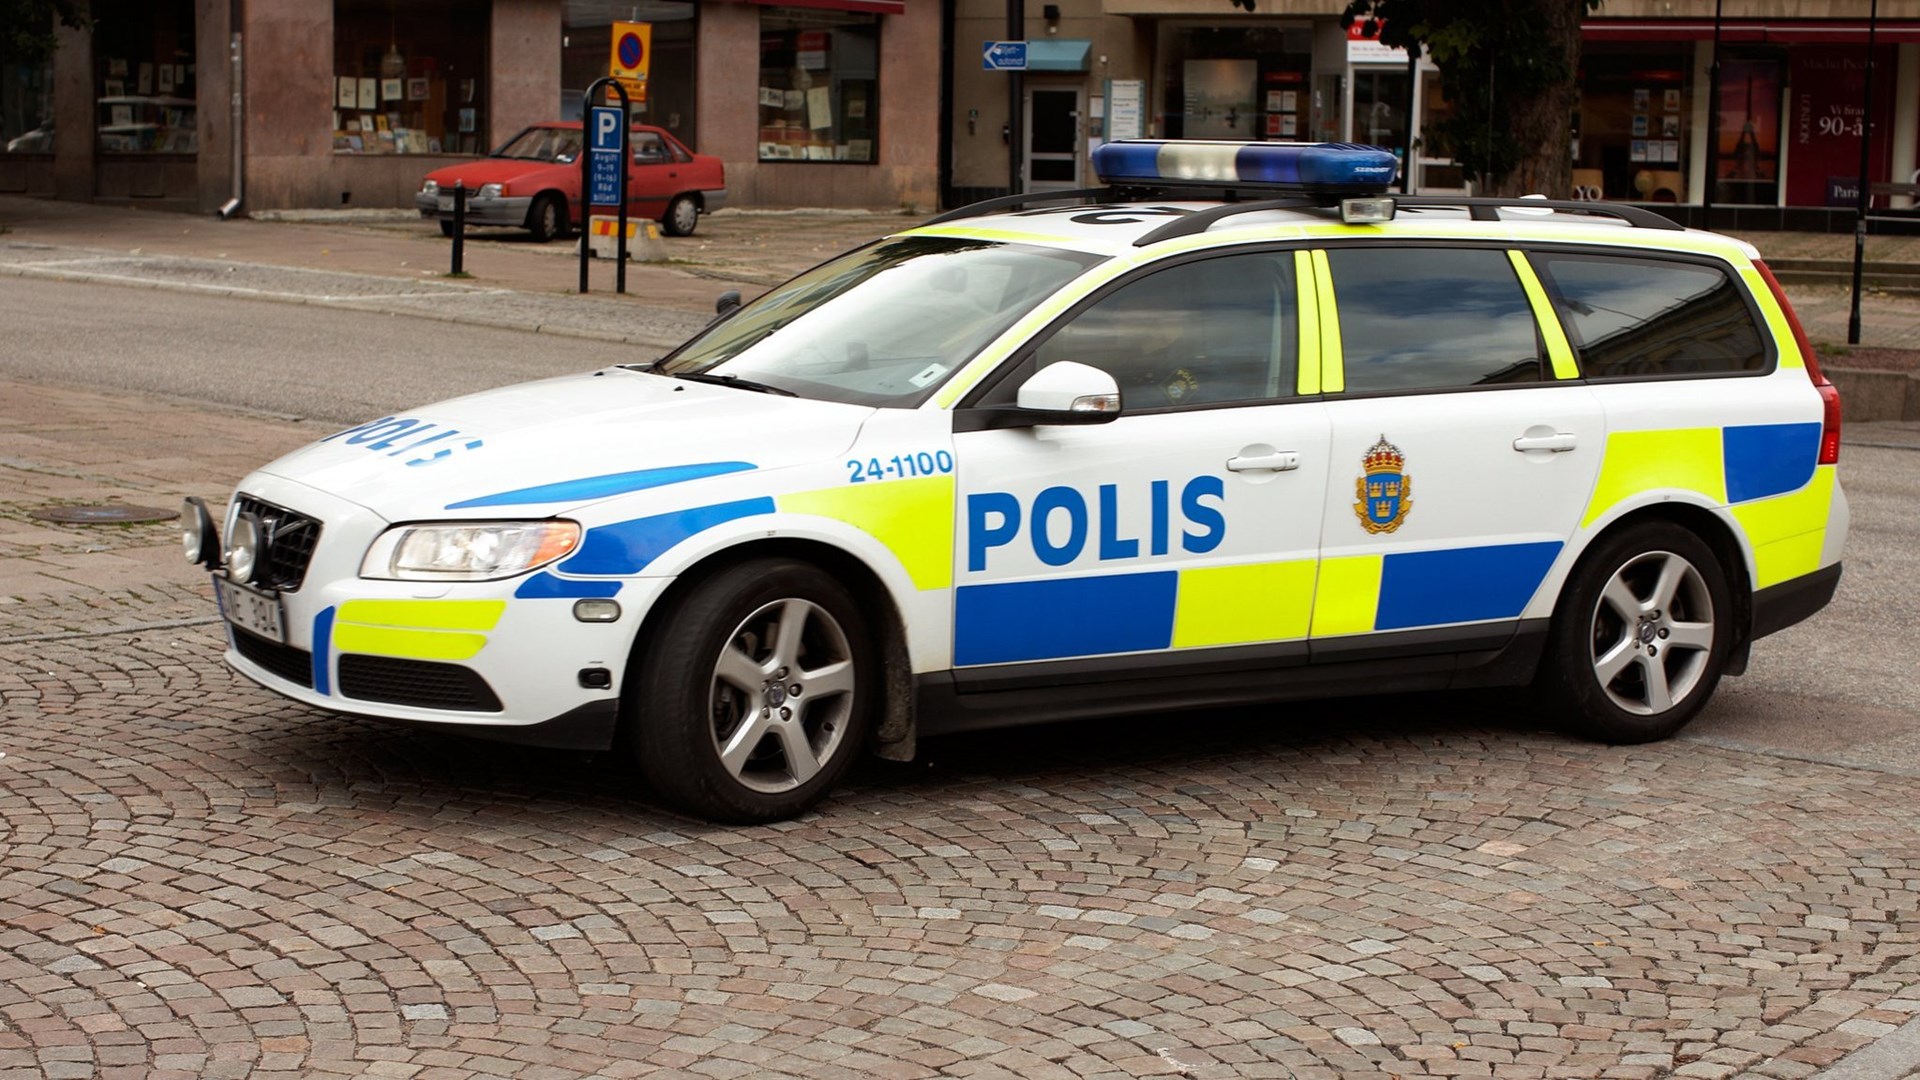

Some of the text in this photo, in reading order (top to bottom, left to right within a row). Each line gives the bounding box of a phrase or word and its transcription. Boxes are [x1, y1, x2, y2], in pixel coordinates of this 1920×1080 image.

[598, 112, 616, 146] P
[594, 153, 618, 162] Avgift
[847, 450, 953, 483] 24-1100
[967, 475, 1226, 572] POLIS
